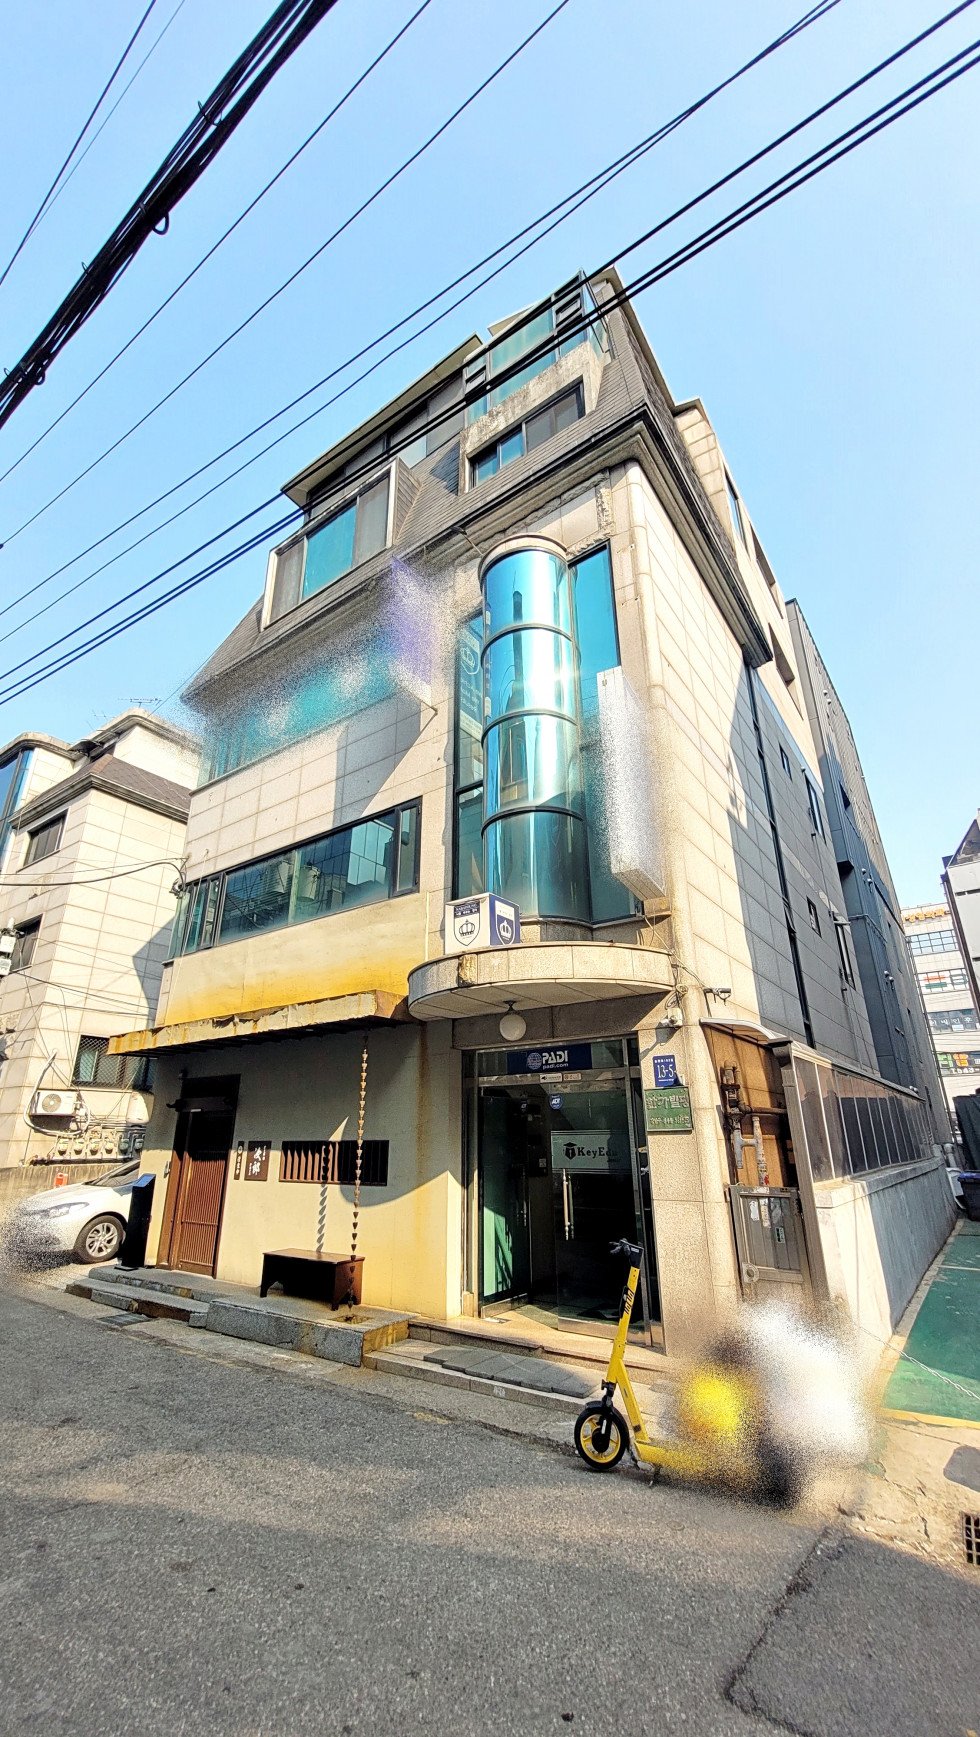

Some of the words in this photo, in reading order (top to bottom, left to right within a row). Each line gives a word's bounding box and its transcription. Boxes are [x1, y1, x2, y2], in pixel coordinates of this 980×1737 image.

[542, 1050, 568, 1064] PADI
[542, 1062, 569, 1070] padi.com
[657, 1064, 674, 1079] 13-5
[577, 1146, 618, 1158] KeyEdu
